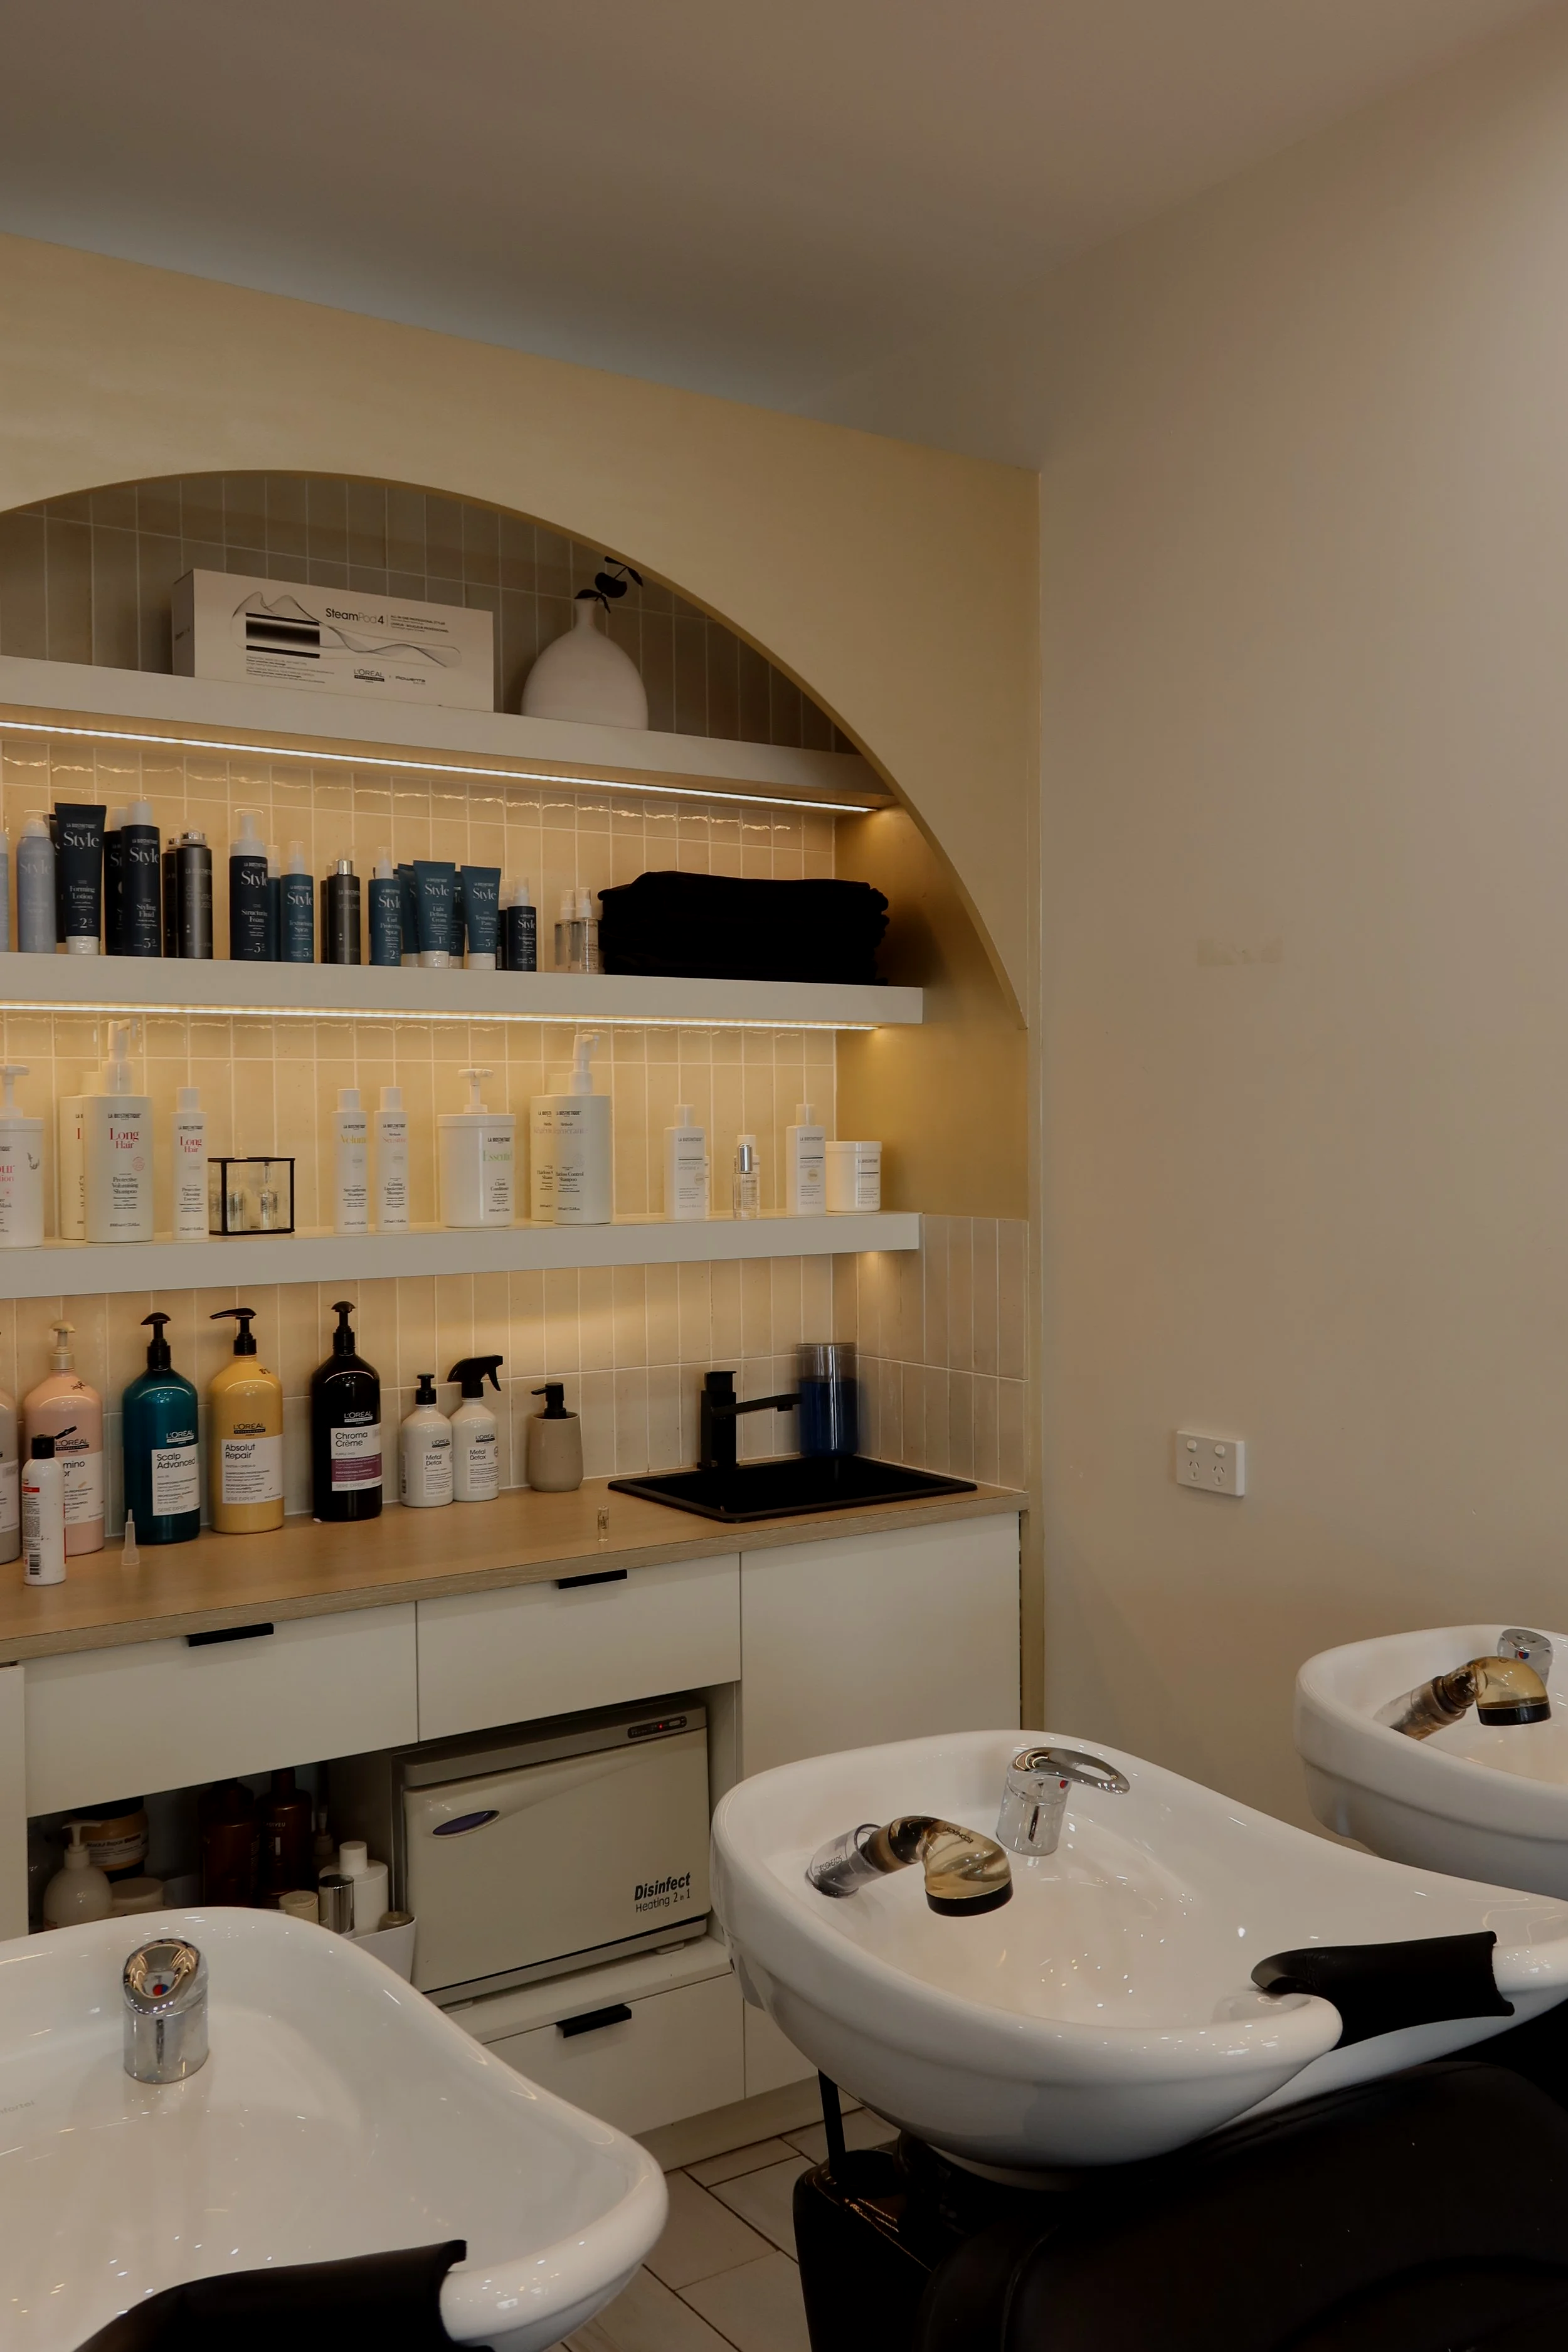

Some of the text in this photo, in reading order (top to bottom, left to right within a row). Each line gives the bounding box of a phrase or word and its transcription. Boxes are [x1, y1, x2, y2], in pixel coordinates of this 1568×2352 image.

[354, 669, 384, 677] L'ORÉAL
[63, 832, 100, 849] Style
[129, 847, 159, 865] Style
[425, 884, 450, 898] Style
[473, 888, 497, 901] Style
[80, 918, 87, 928] 2
[518, 919, 536, 930] Style
[110, 1128, 139, 1142] Long
[341, 1134, 366, 1144] Volum
[115, 1140, 134, 1149] Hair
[181, 1136, 203, 1147] Long
[166, 1430, 194, 1439] L'ORÉAL
[336, 1432, 368, 1440] Chroma
[336, 1439, 363, 1448] Crème
[157, 1453, 181, 1461] Scalp
[226, 1452, 252, 1460] Repair
[63, 1461, 85, 1469] mino
[157, 1457, 196, 1470] Advanced
[634, 1872, 691, 1901] Disinfect
[636, 1897, 670, 1913] Heating
[674, 1892, 678, 1903] 2
[687, 1888, 691, 1899] 1
